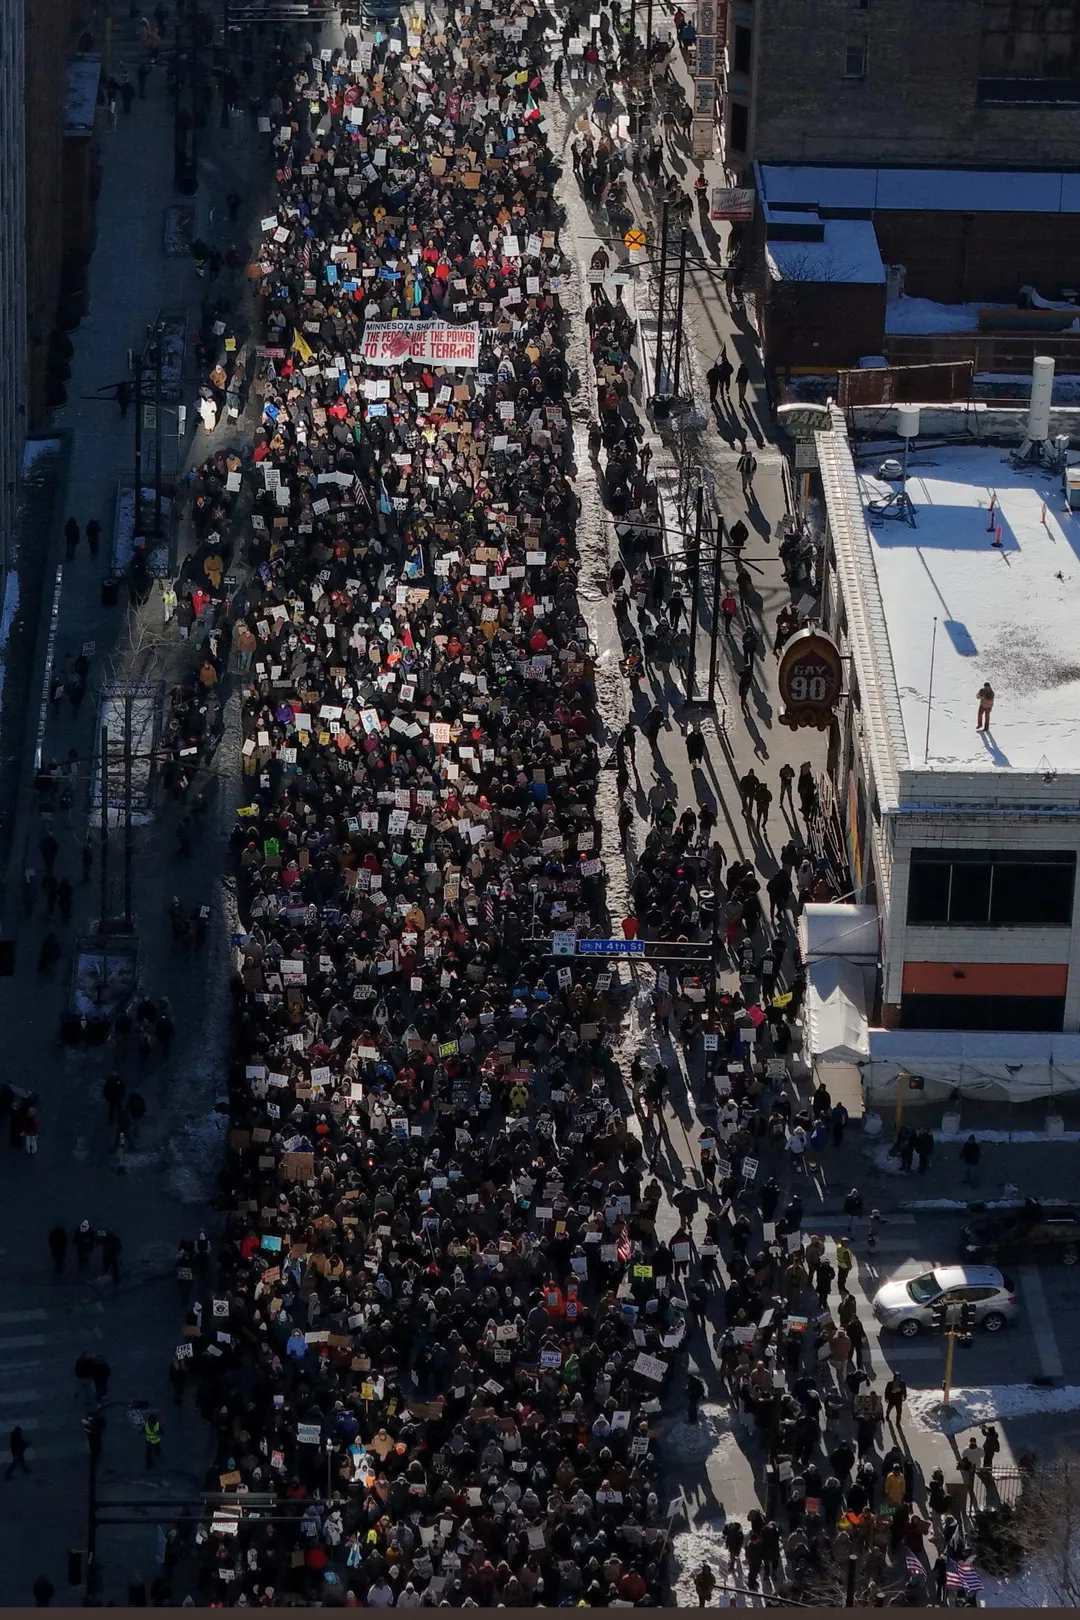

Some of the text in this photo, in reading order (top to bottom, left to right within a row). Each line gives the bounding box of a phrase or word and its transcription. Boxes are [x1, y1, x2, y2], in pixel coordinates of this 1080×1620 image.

[366, 322, 413, 330] MINNESOTA
[416, 322, 435, 330] SHUT
[366, 331, 381, 342] THE
[430, 331, 444, 342] THE
[447, 331, 475, 343] POWER
[365, 343, 377, 358] TO
[408, 342, 426, 357] ICE
[794, 665, 826, 676] GAY
[594, 942, 642, 950] N 4th St
